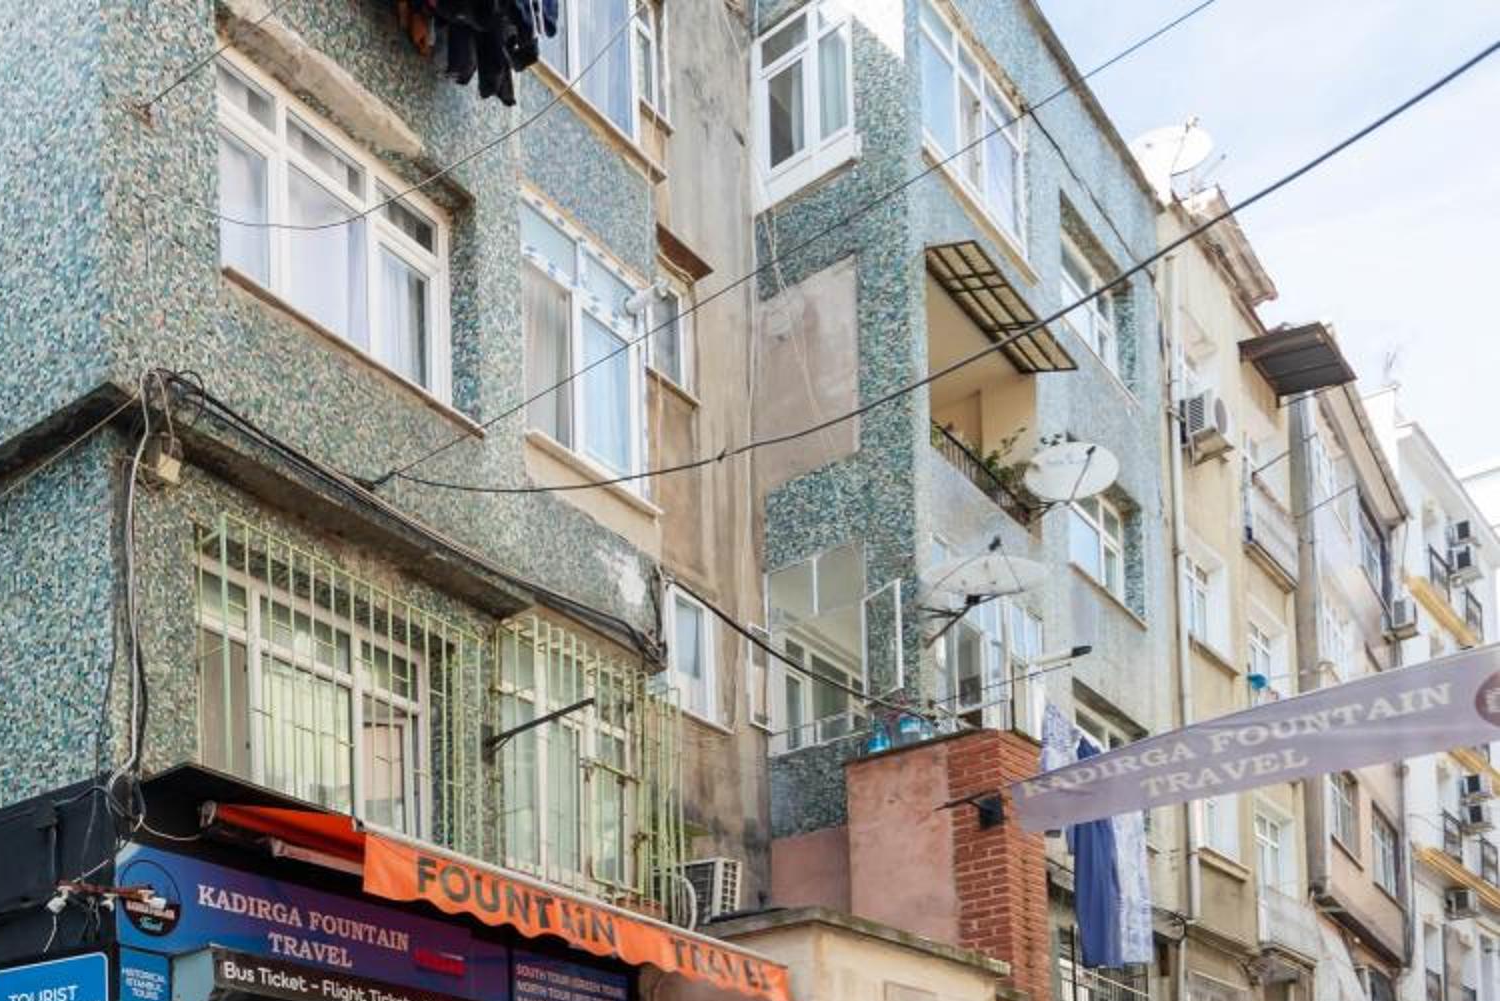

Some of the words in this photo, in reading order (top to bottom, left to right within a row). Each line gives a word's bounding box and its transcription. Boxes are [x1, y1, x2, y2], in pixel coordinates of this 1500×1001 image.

[1020, 742, 1195, 802] KADIRGA
[1207, 682, 1453, 757] FOUNTAIN
[1137, 749, 1309, 802] TRAVEL
[197, 884, 303, 929] KADIRGA
[308, 911, 409, 951] FOUNTAIN
[267, 931, 353, 969] TRAVEL
[222, 960, 255, 983] Bus
[257, 966, 309, 994] Ticket
